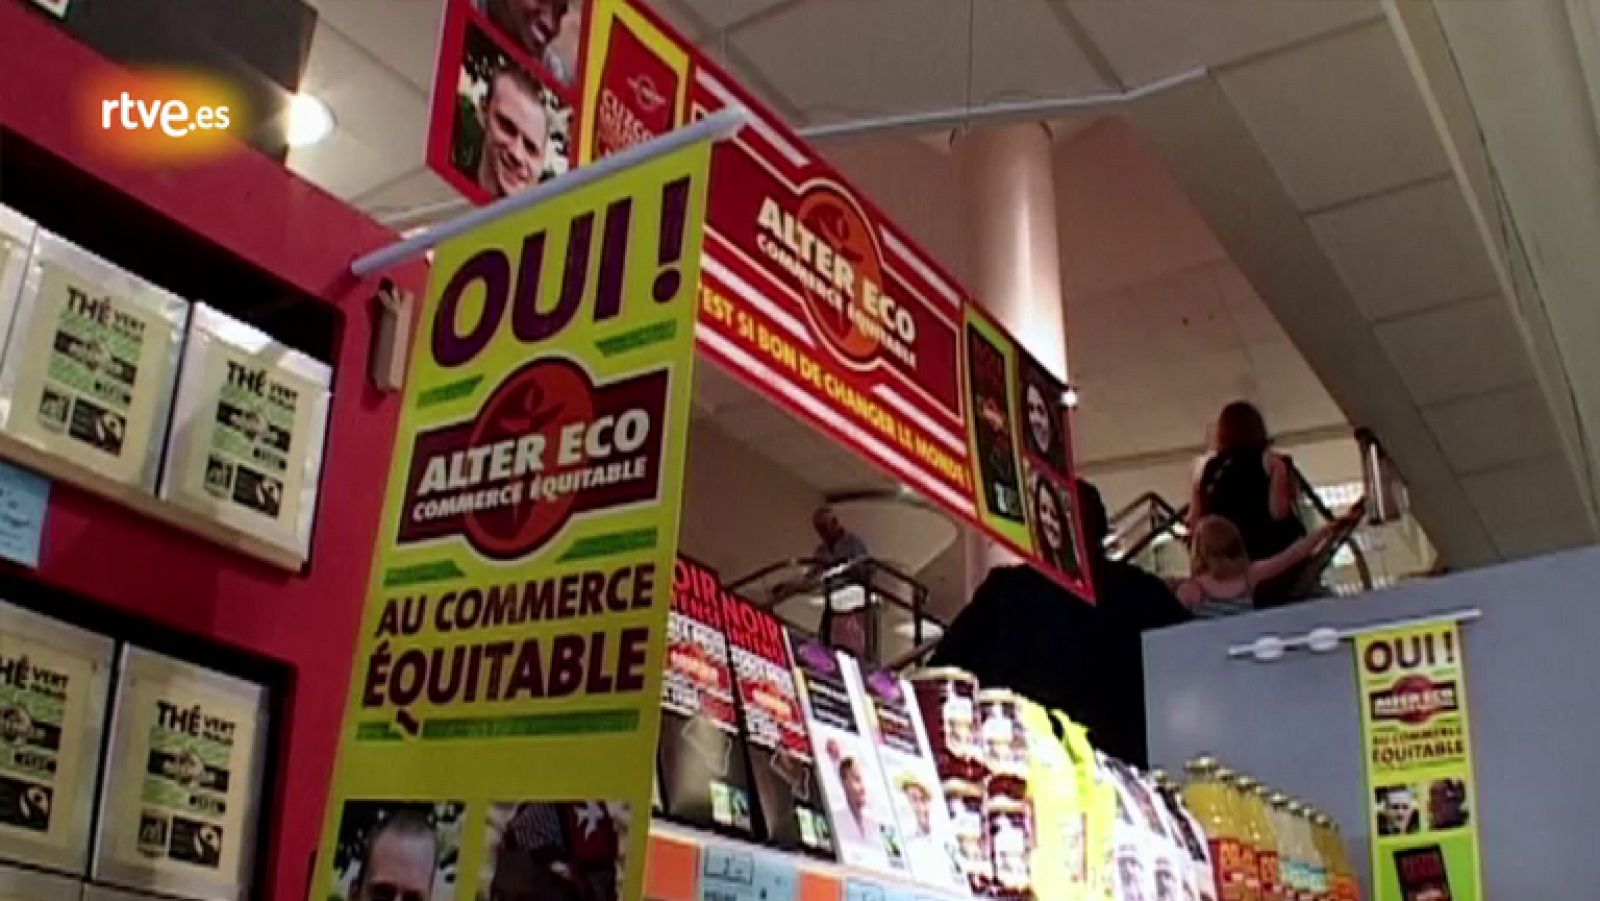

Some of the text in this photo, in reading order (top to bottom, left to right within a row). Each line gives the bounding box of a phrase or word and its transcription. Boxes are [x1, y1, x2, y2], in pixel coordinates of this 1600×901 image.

[431, 175, 690, 367] OUI !
[756, 197, 916, 344] ALTER ECO
[66, 285, 111, 328] THÉ
[227, 361, 268, 397] THÉ
[758, 317, 798, 371] BON
[801, 342, 823, 386] DE
[416, 408, 651, 497] ALTER ECO
[412, 456, 647, 522] COMMERCE ÉQUITABLE
[374, 595, 427, 638] AU
[434, 562, 655, 632] COMMERCE
[673, 558, 720, 600] OIR
[0, 654, 30, 689] HÉ
[362, 628, 650, 734] ÉQUITABLE
[1364, 631, 1455, 674] OUI !
[156, 700, 201, 737] THÉ
